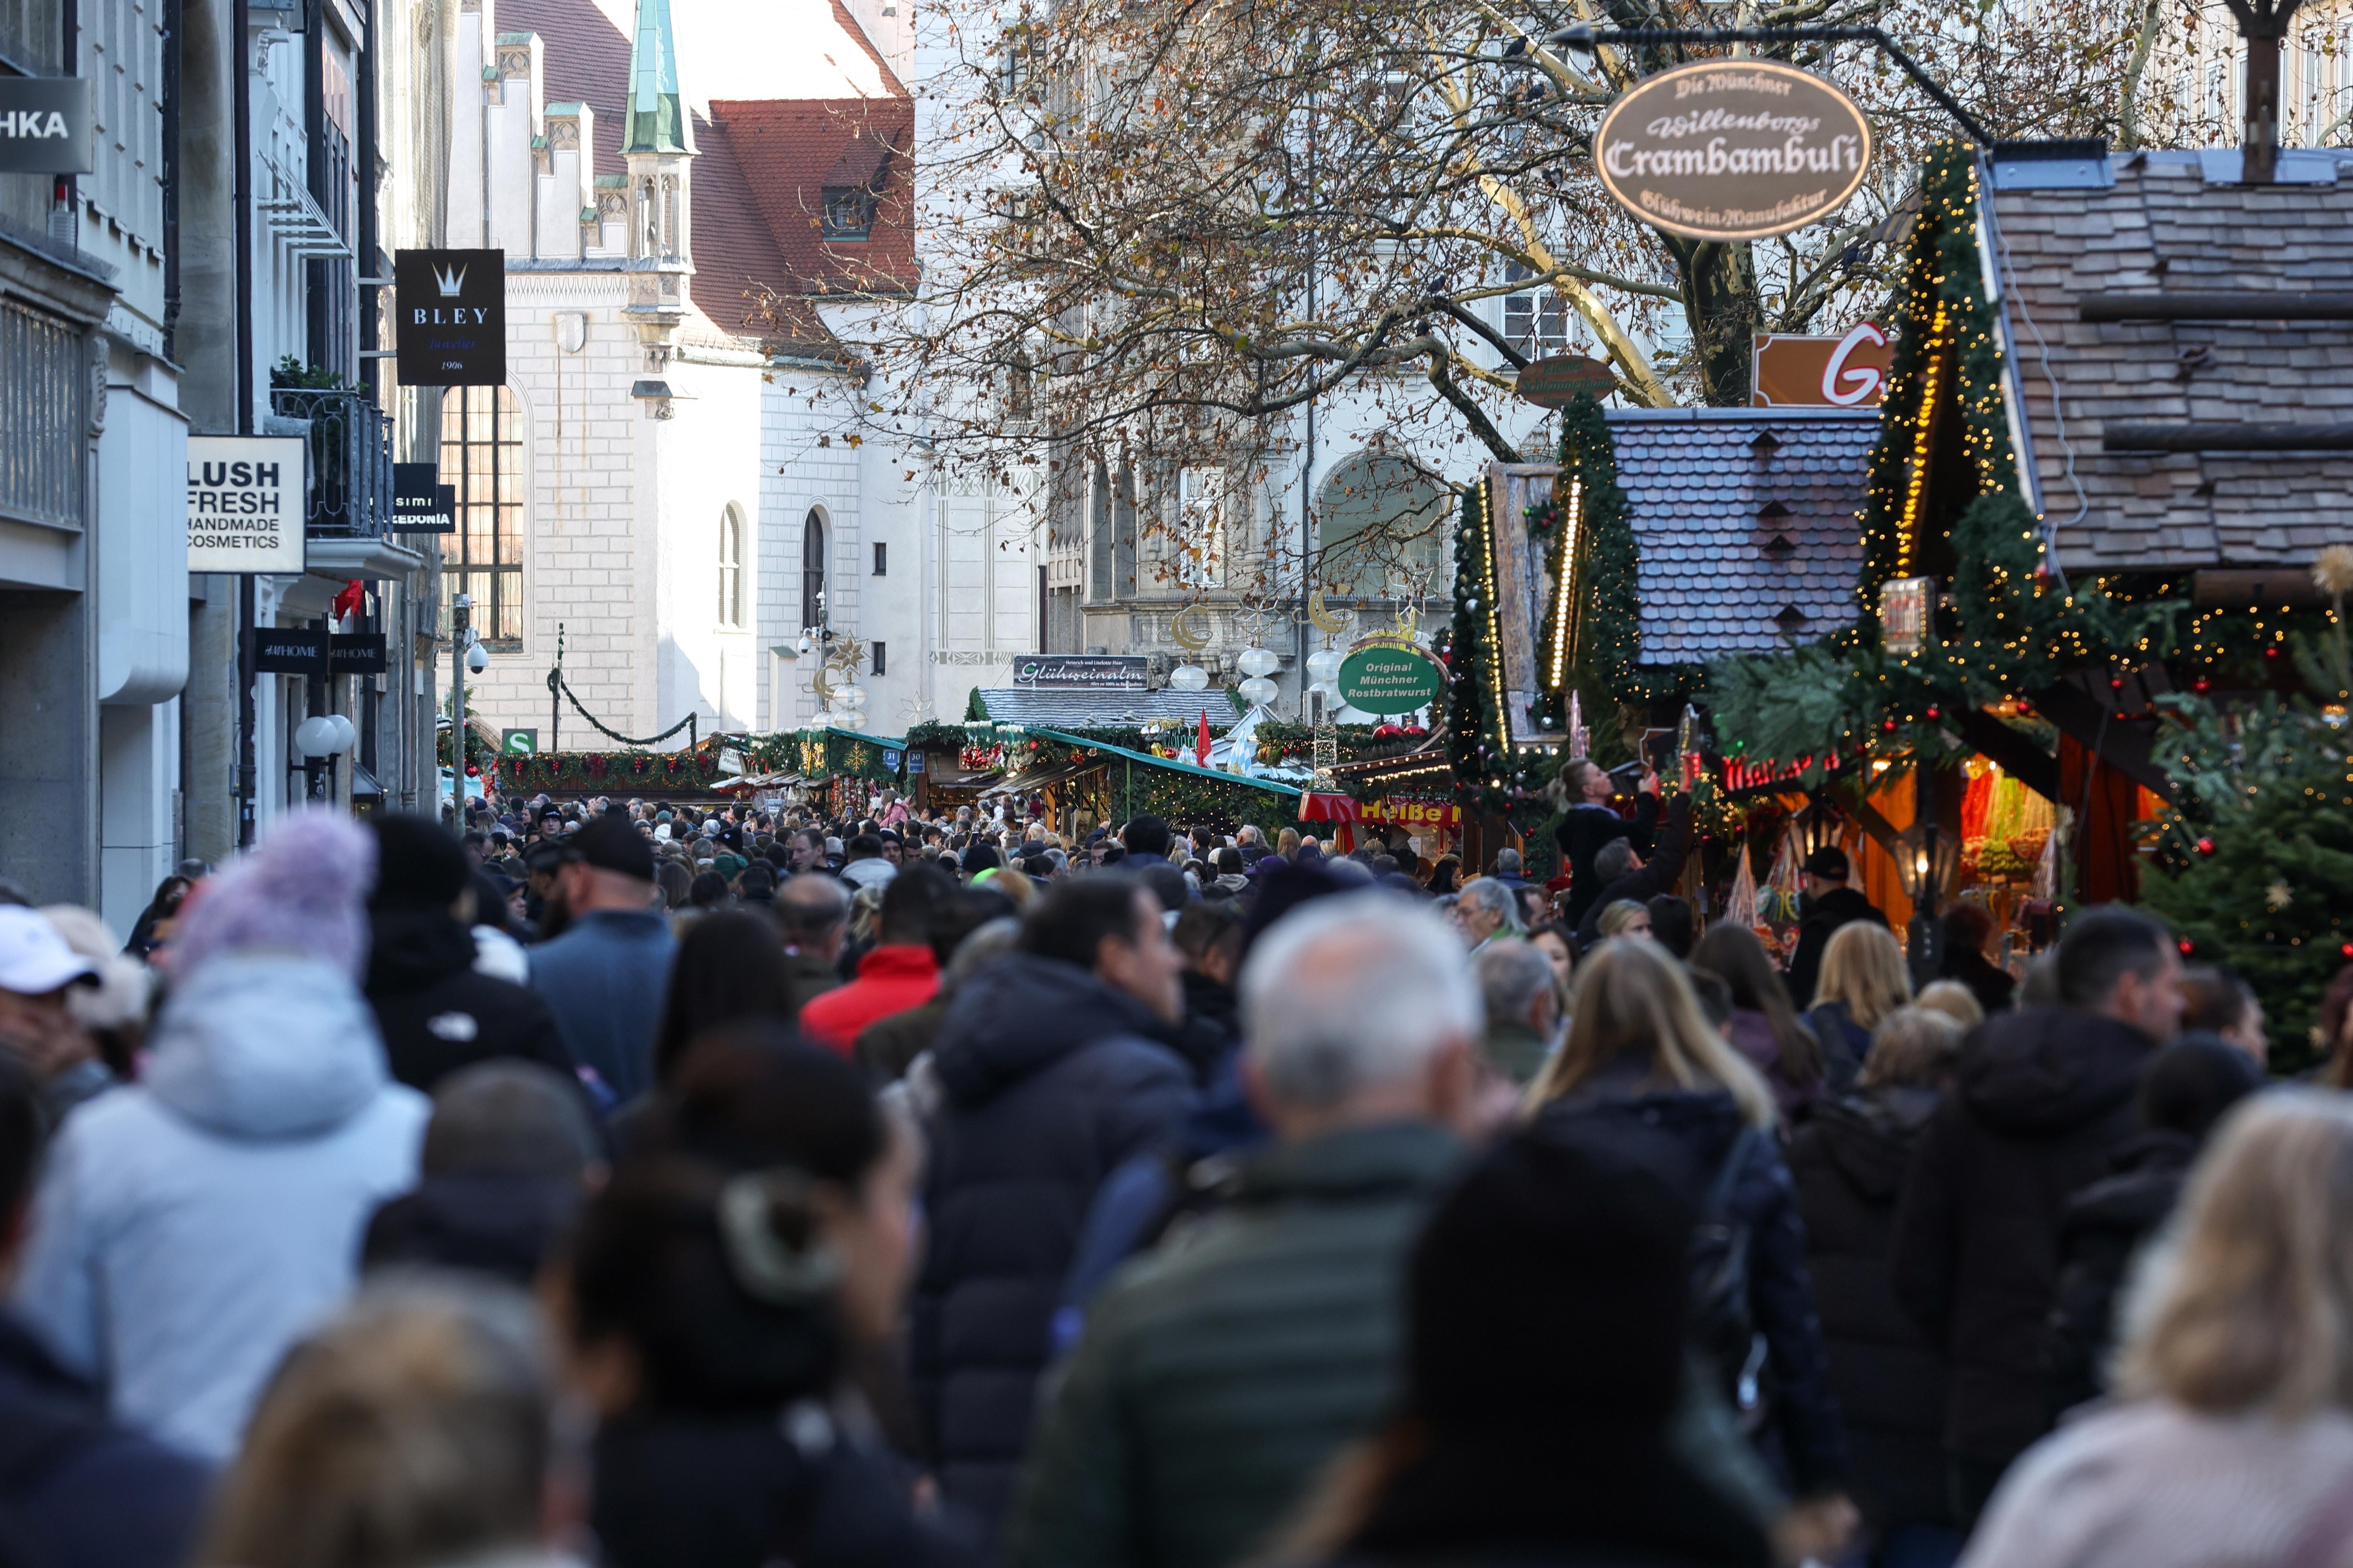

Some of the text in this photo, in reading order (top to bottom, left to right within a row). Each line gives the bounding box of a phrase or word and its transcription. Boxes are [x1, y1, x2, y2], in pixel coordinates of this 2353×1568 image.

[1674, 71, 1792, 99] Die Münchner
[1645, 107, 1822, 140] Willenborgs
[1604, 134, 1860, 179] Crambambuli
[414, 307, 487, 324] BLEY
[428, 337, 477, 351] Juwelier
[441, 361, 463, 370] 1906
[1821, 322, 1889, 406] G
[1521, 376, 1612, 393] Schlemmerhaus
[187, 461, 278, 487] LUSH
[281, 645, 319, 657] HOME
[1018, 661, 1143, 683] Glühweinalm
[1366, 663, 1412, 673] Original
[1360, 676, 1419, 685] Münchner
[1348, 687, 1431, 698] Rostbratwurst
[509, 733, 529, 753] S
[1361, 800, 1442, 822] Heiße
